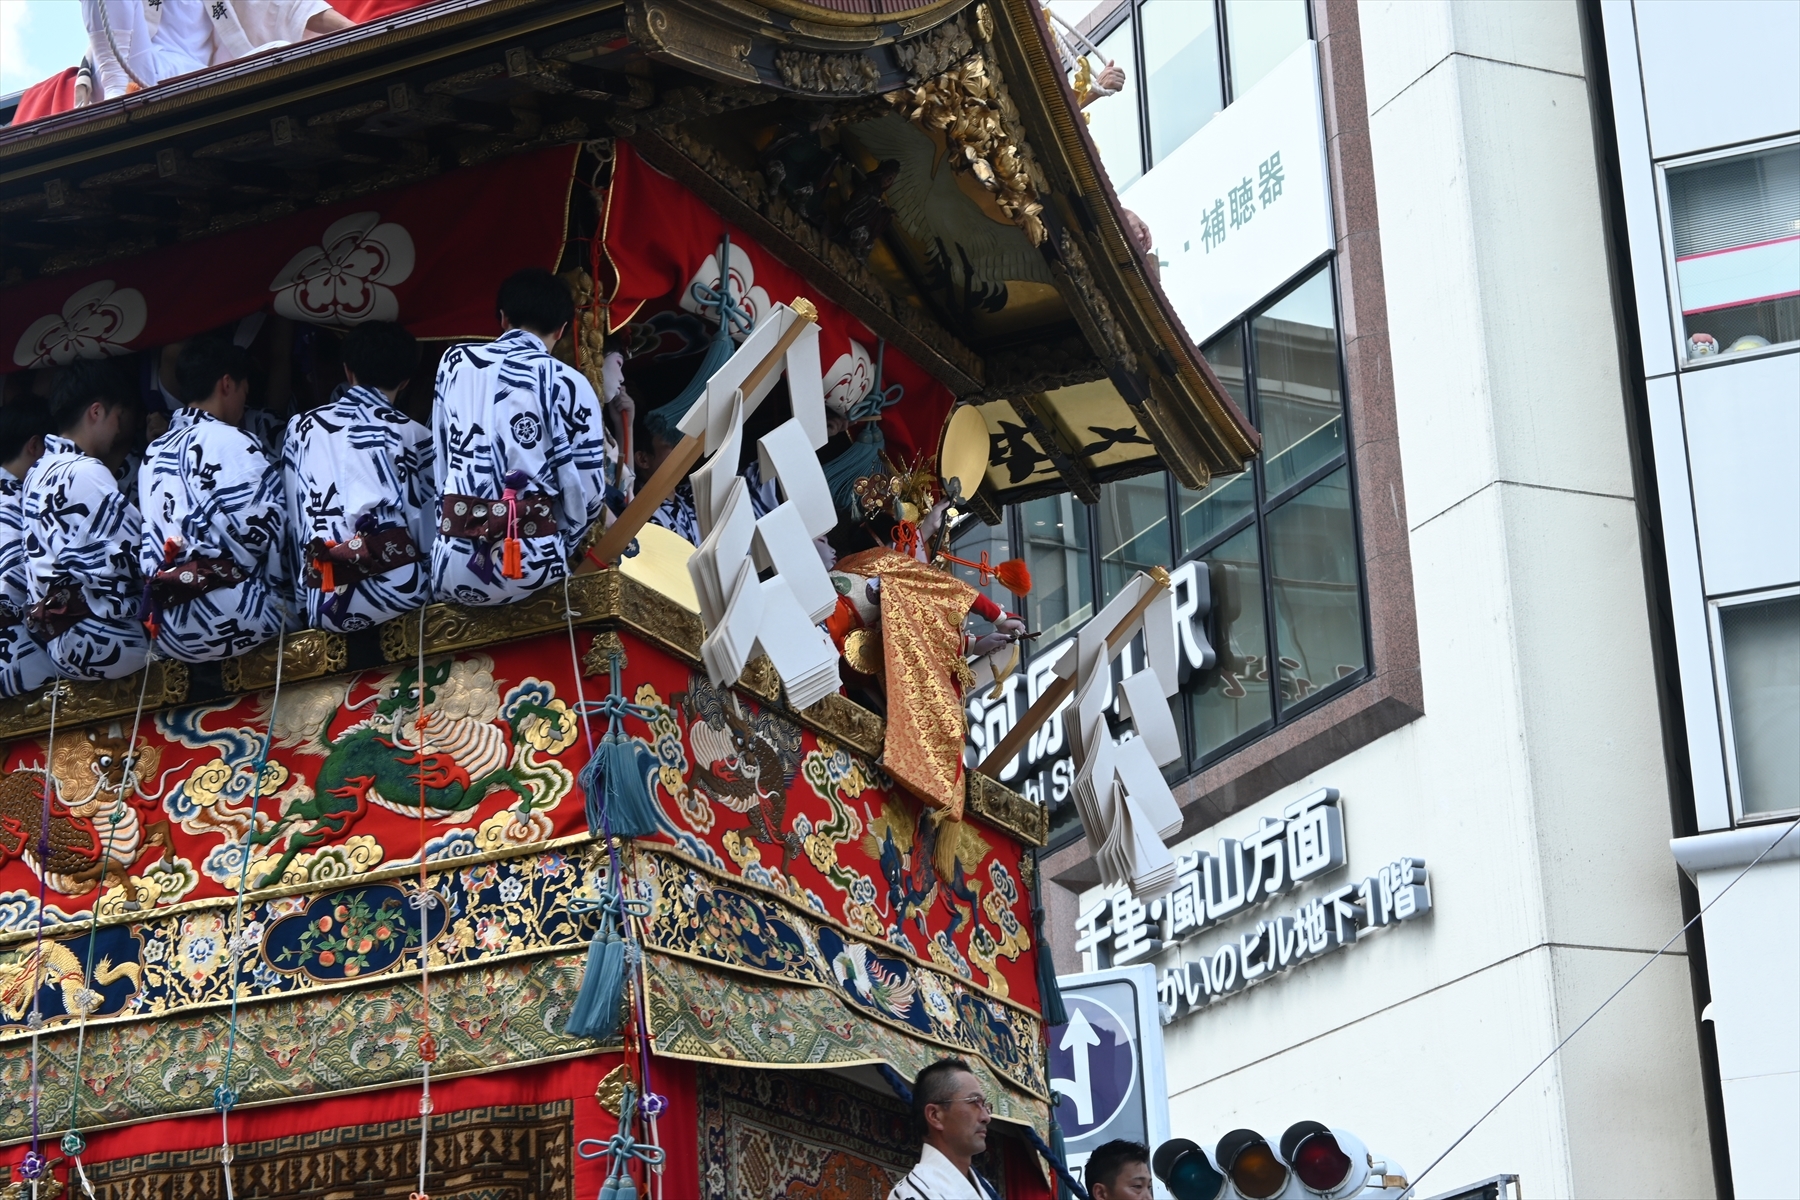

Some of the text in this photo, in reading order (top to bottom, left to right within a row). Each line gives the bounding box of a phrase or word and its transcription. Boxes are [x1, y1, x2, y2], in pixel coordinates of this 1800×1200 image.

[1074, 787, 1330, 972] 千里・嵐山方面
[1157, 857, 1416, 1016] かいのビル地下1階
